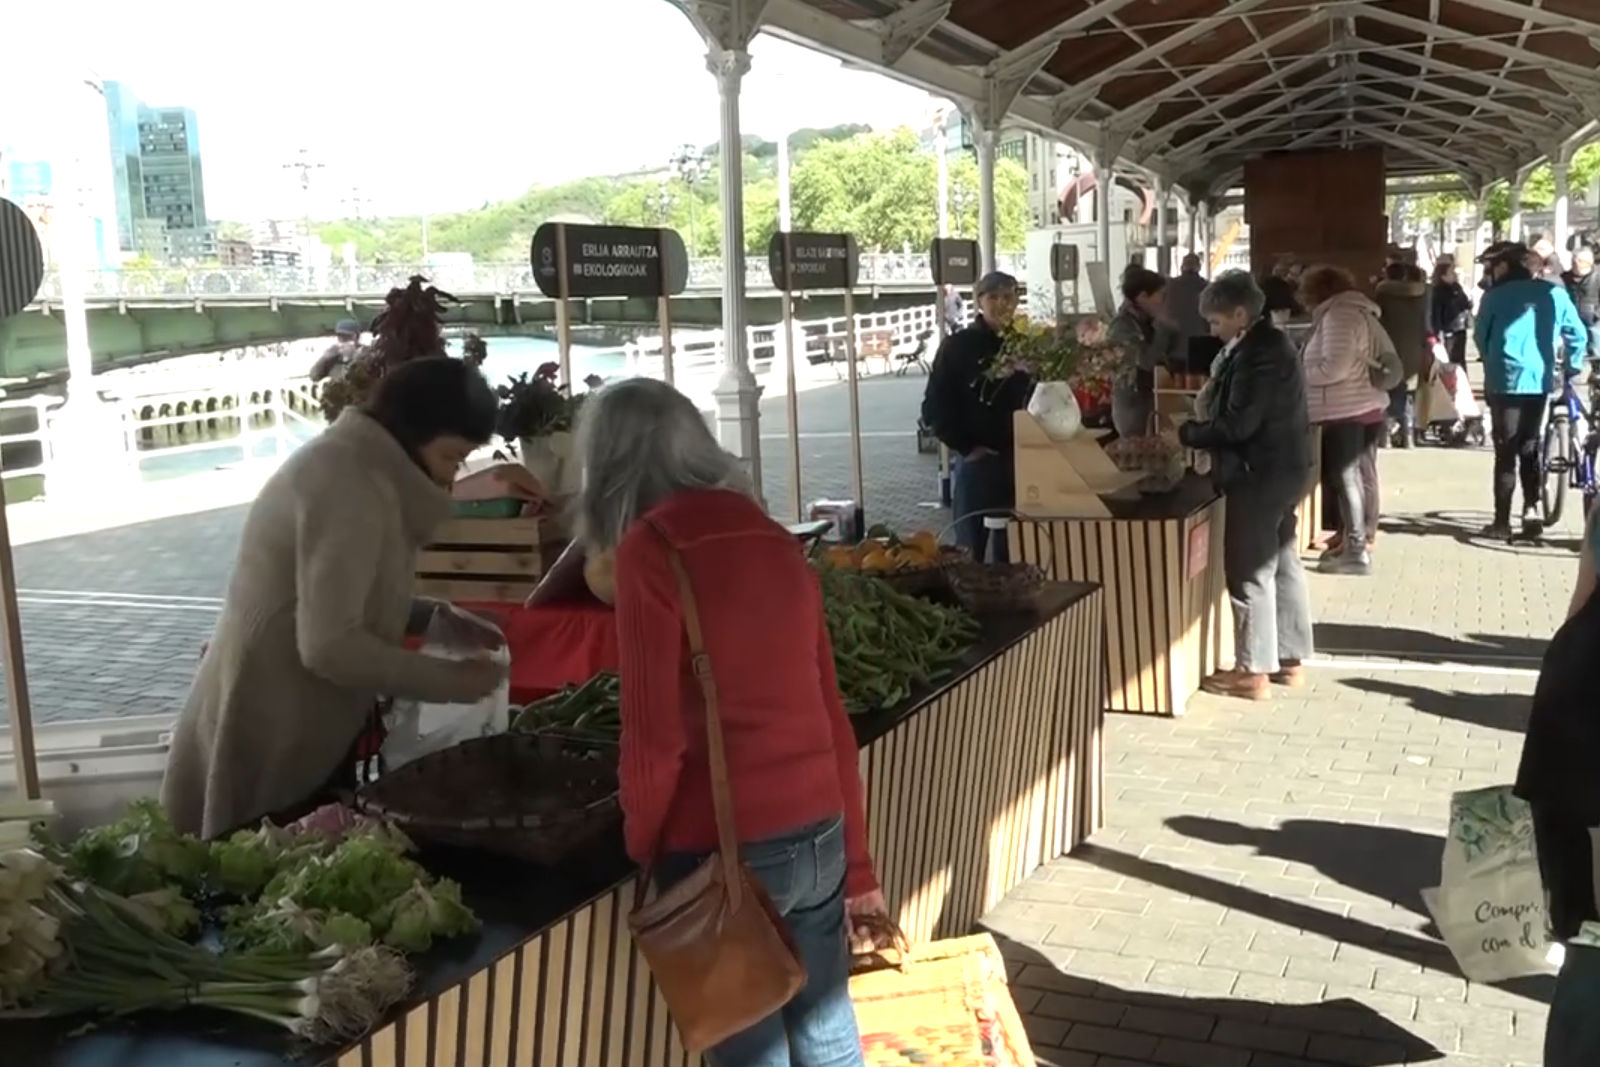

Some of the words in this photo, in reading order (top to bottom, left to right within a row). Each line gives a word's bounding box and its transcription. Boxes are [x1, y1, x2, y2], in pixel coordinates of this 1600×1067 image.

[612, 244, 658, 258] ARRAUTZA
[583, 263, 647, 277] EKOLOGIKOAK
[1481, 937, 1511, 953] con
